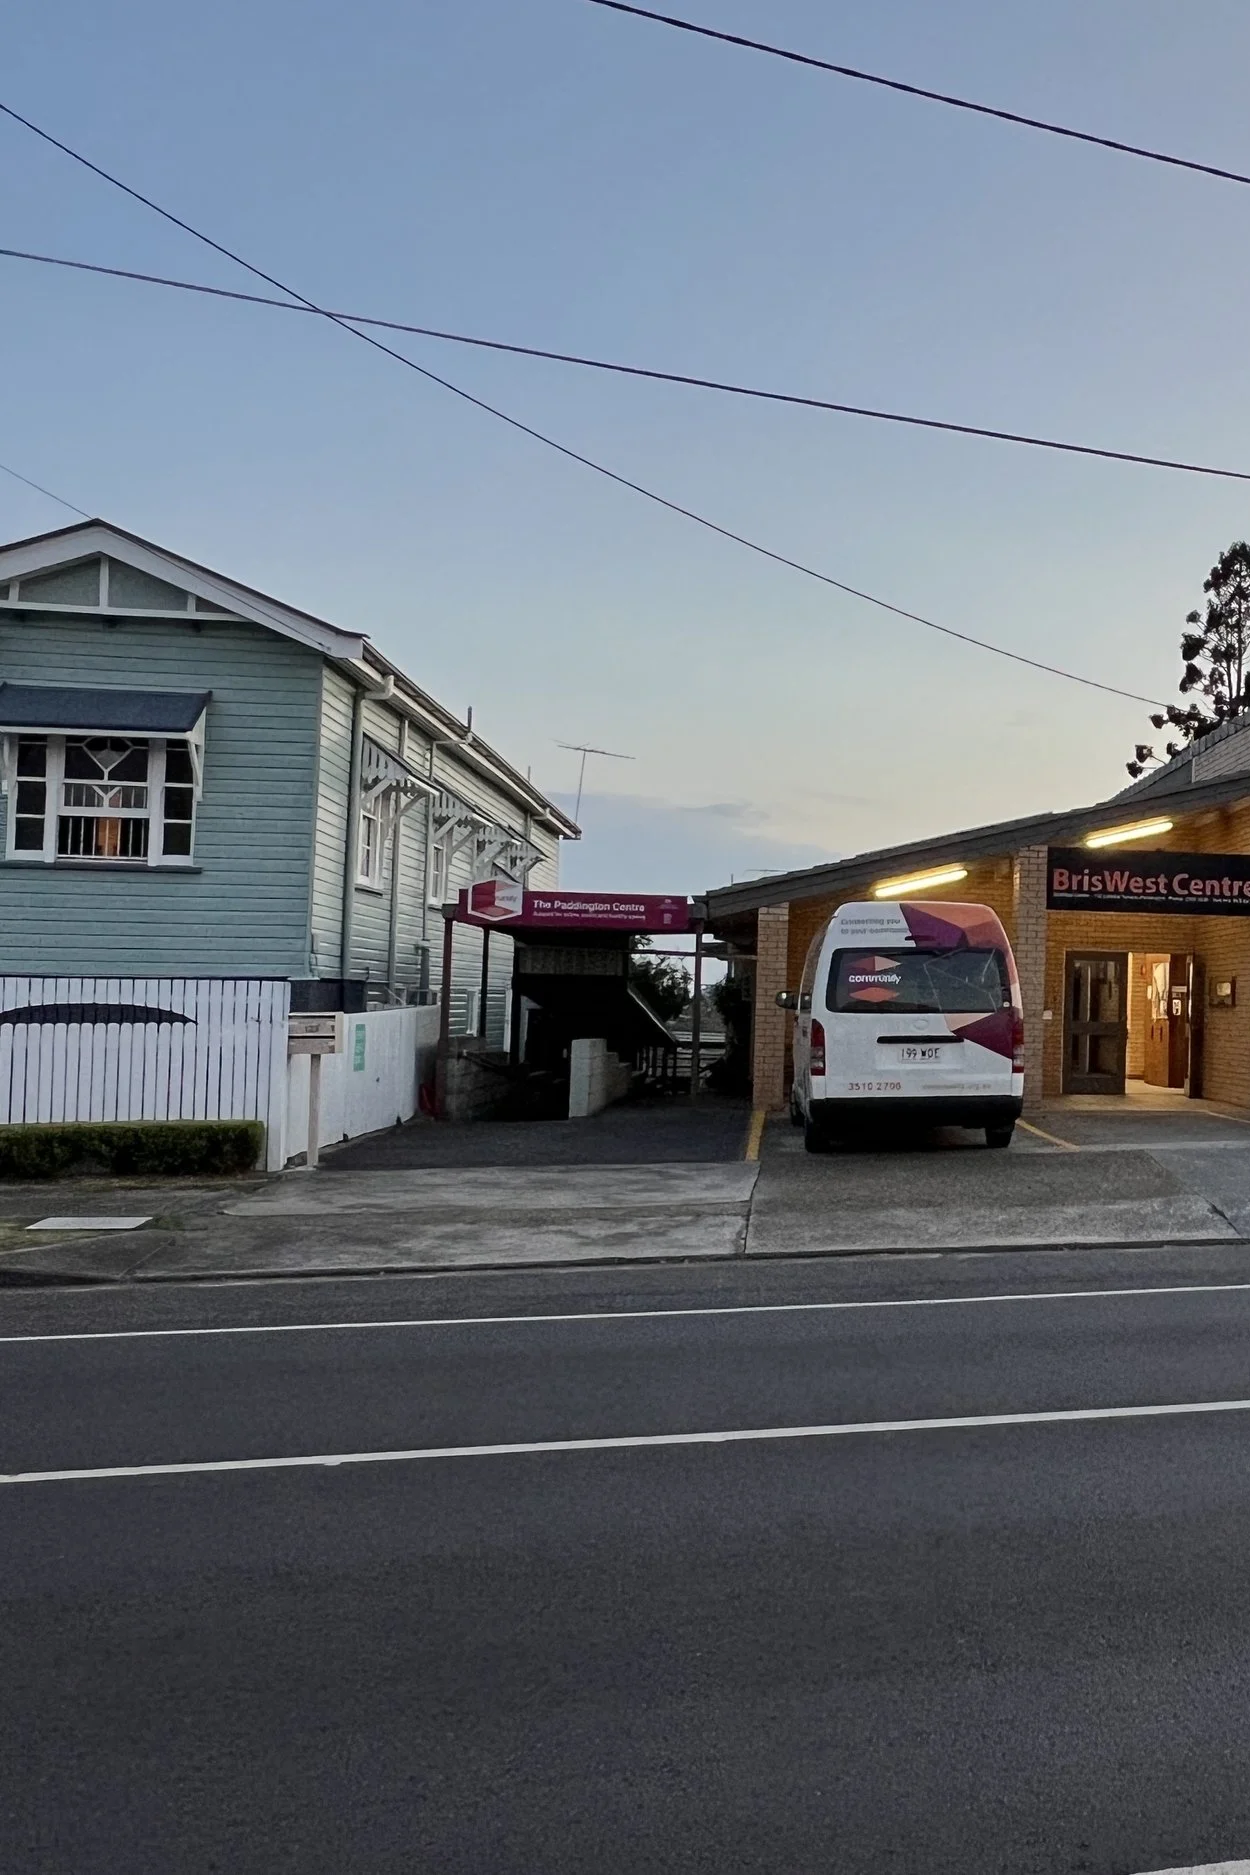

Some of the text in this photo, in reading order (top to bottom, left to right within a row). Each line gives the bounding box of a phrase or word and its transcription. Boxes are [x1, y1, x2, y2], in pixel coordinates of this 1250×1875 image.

[1053, 868, 1168, 894] BrisWest
[533, 900, 645, 912] The Paddington Centre
[848, 1082, 873, 1091] 3510
